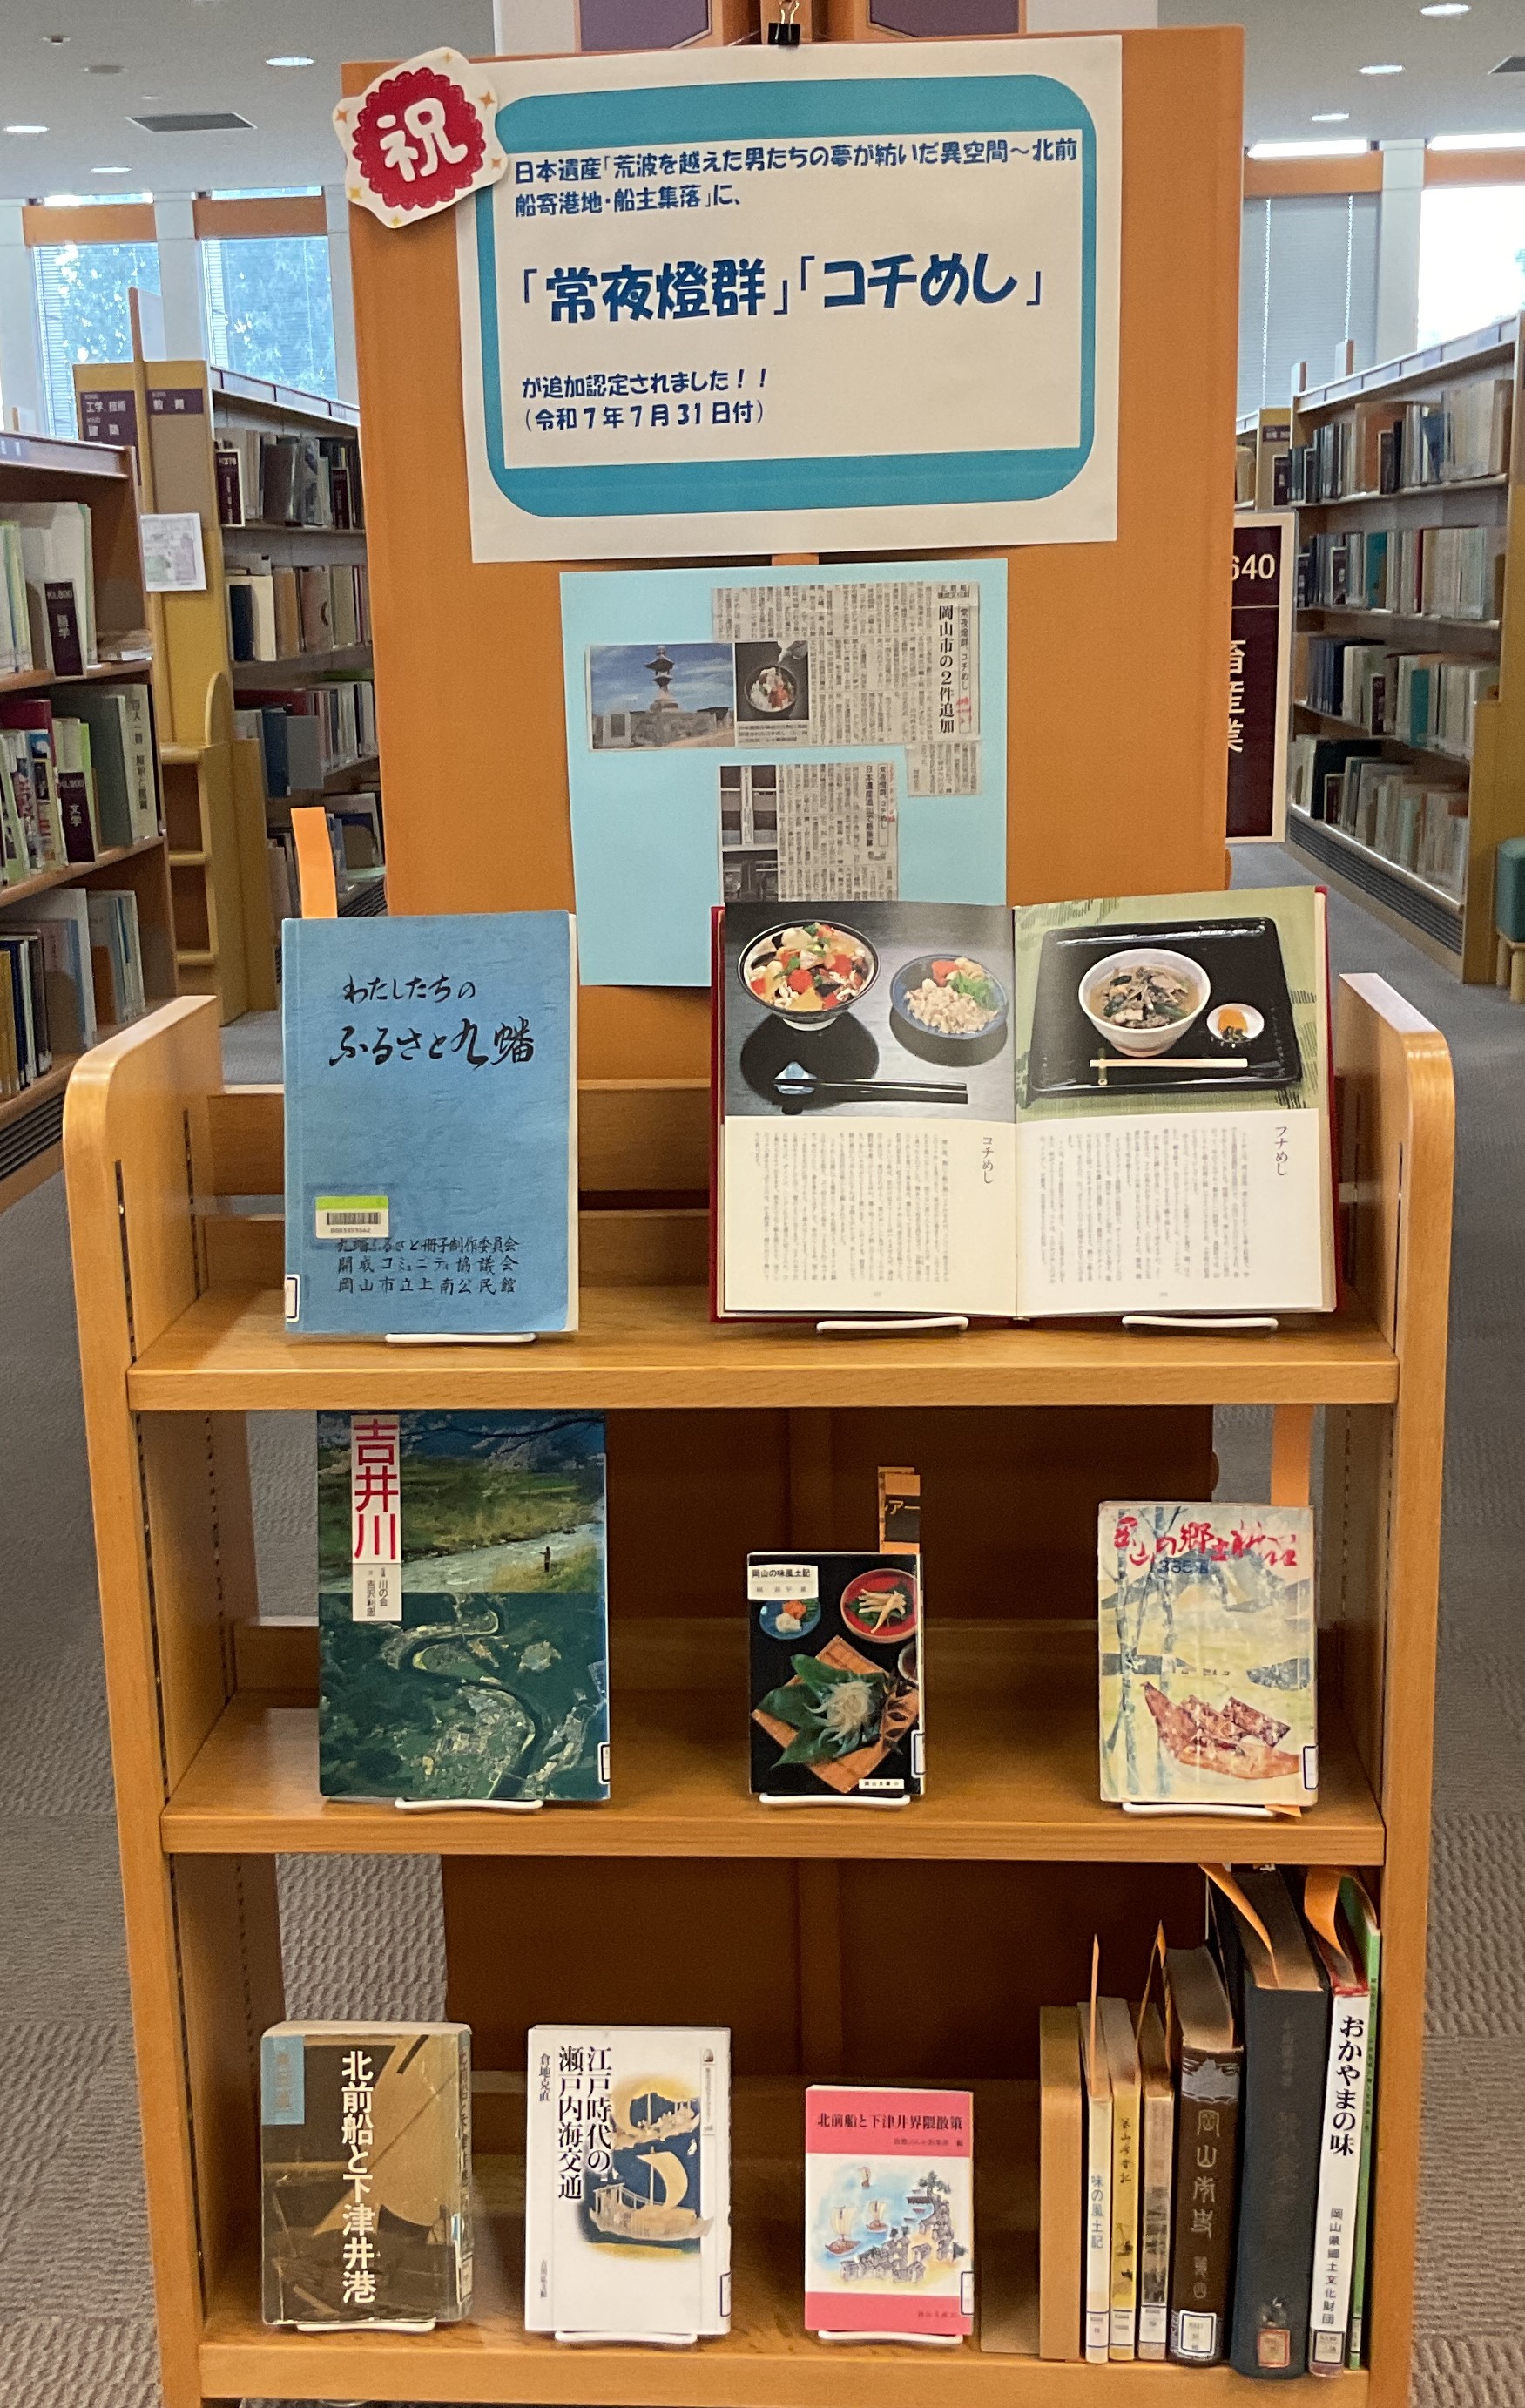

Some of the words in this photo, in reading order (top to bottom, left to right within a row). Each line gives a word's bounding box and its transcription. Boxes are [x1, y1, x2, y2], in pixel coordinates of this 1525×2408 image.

[377, 94, 469, 184] 祝
[939, 605, 954, 734] 岡山市の2件追加
[343, 973, 476, 1004] わたしたちの
[982, 1136, 995, 1184] コチめし
[1274, 1126, 1288, 1176] フナめし
[338, 1276, 517, 1296] 岡山市立上南公民館
[354, 1418, 399, 1561] 吉井川
[557, 2045, 584, 2201] 瀬戸内海交通
[587, 2045, 612, 2173] 江戸時代の
[817, 2111, 963, 2132] 北前船と下津井界隈散策
[1330, 2015, 1365, 2156] おかやまの味
[341, 2050, 377, 2304] 北前船と下津井港
